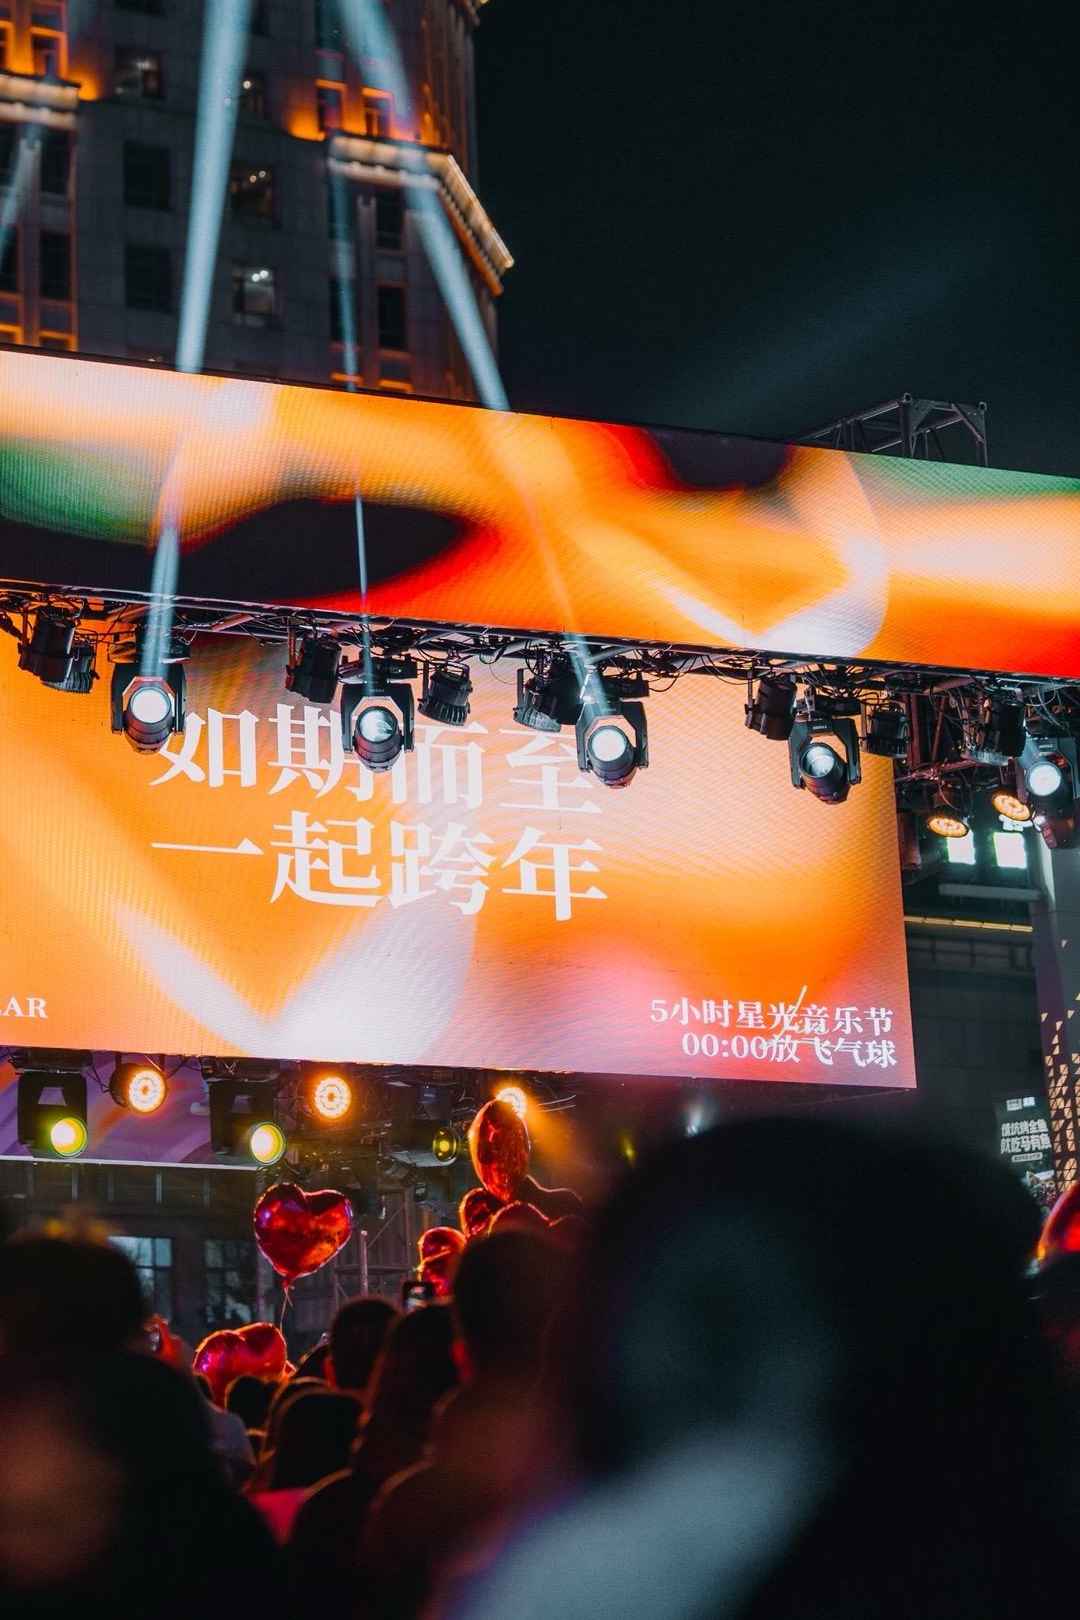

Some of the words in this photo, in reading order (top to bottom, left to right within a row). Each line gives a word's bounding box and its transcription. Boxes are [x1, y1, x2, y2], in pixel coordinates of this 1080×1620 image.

[150, 703, 603, 814] 如期而至
[151, 810, 608, 921] 一起跨年
[649, 997, 894, 1036] 5小时星光音乐节
[681, 1032, 897, 1069] 00:00放飞气球
